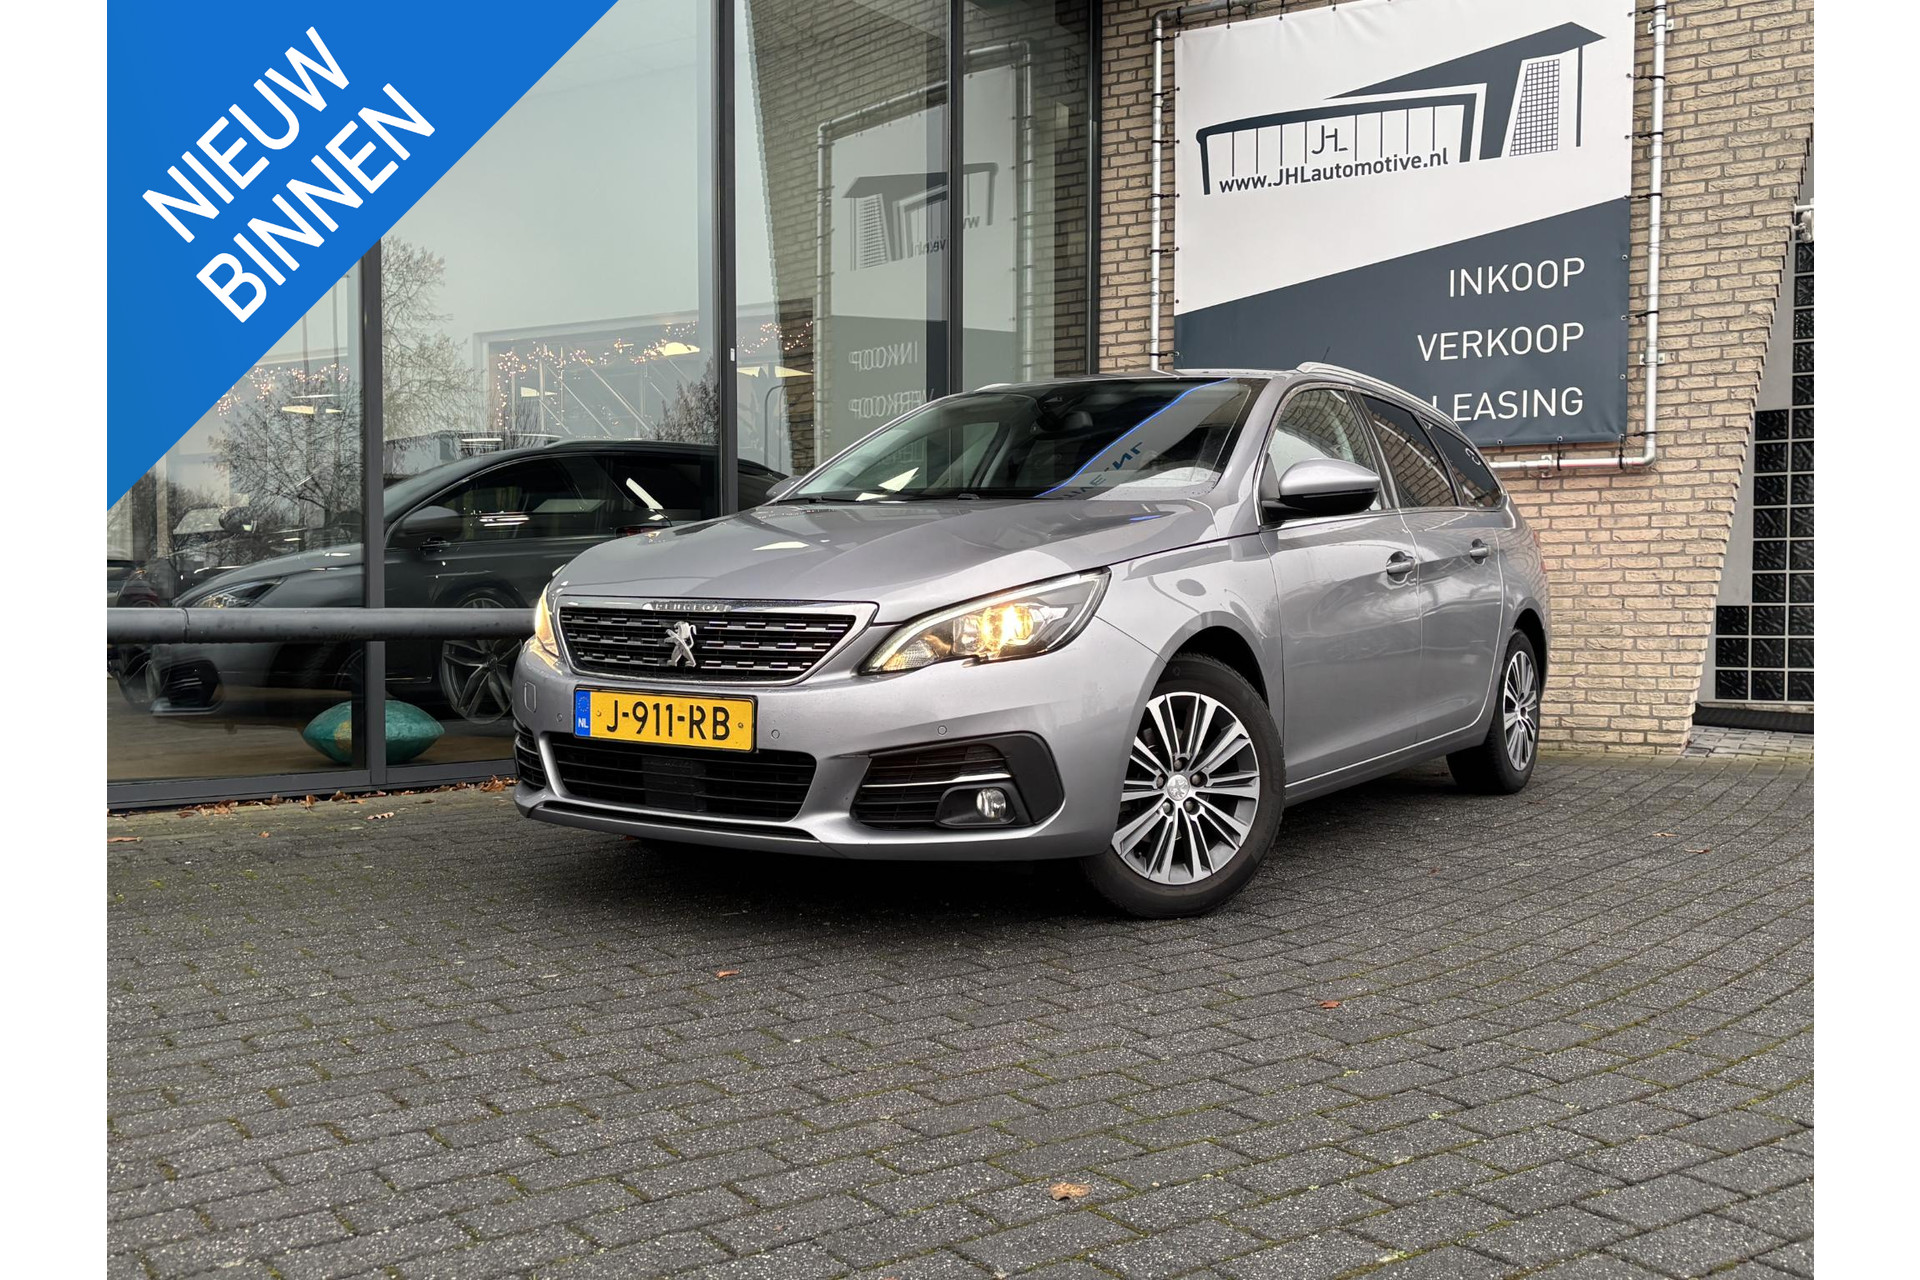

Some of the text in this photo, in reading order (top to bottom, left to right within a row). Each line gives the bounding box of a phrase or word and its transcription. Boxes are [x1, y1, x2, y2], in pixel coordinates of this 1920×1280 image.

[1219, 147, 1448, 193] www.JHLautomotive.nl
[1450, 257, 1585, 297] INKOOP
[1417, 322, 1584, 361] VERKOOP
[578, 717, 590, 729] NL
[606, 699, 730, 741] J-911-RB
